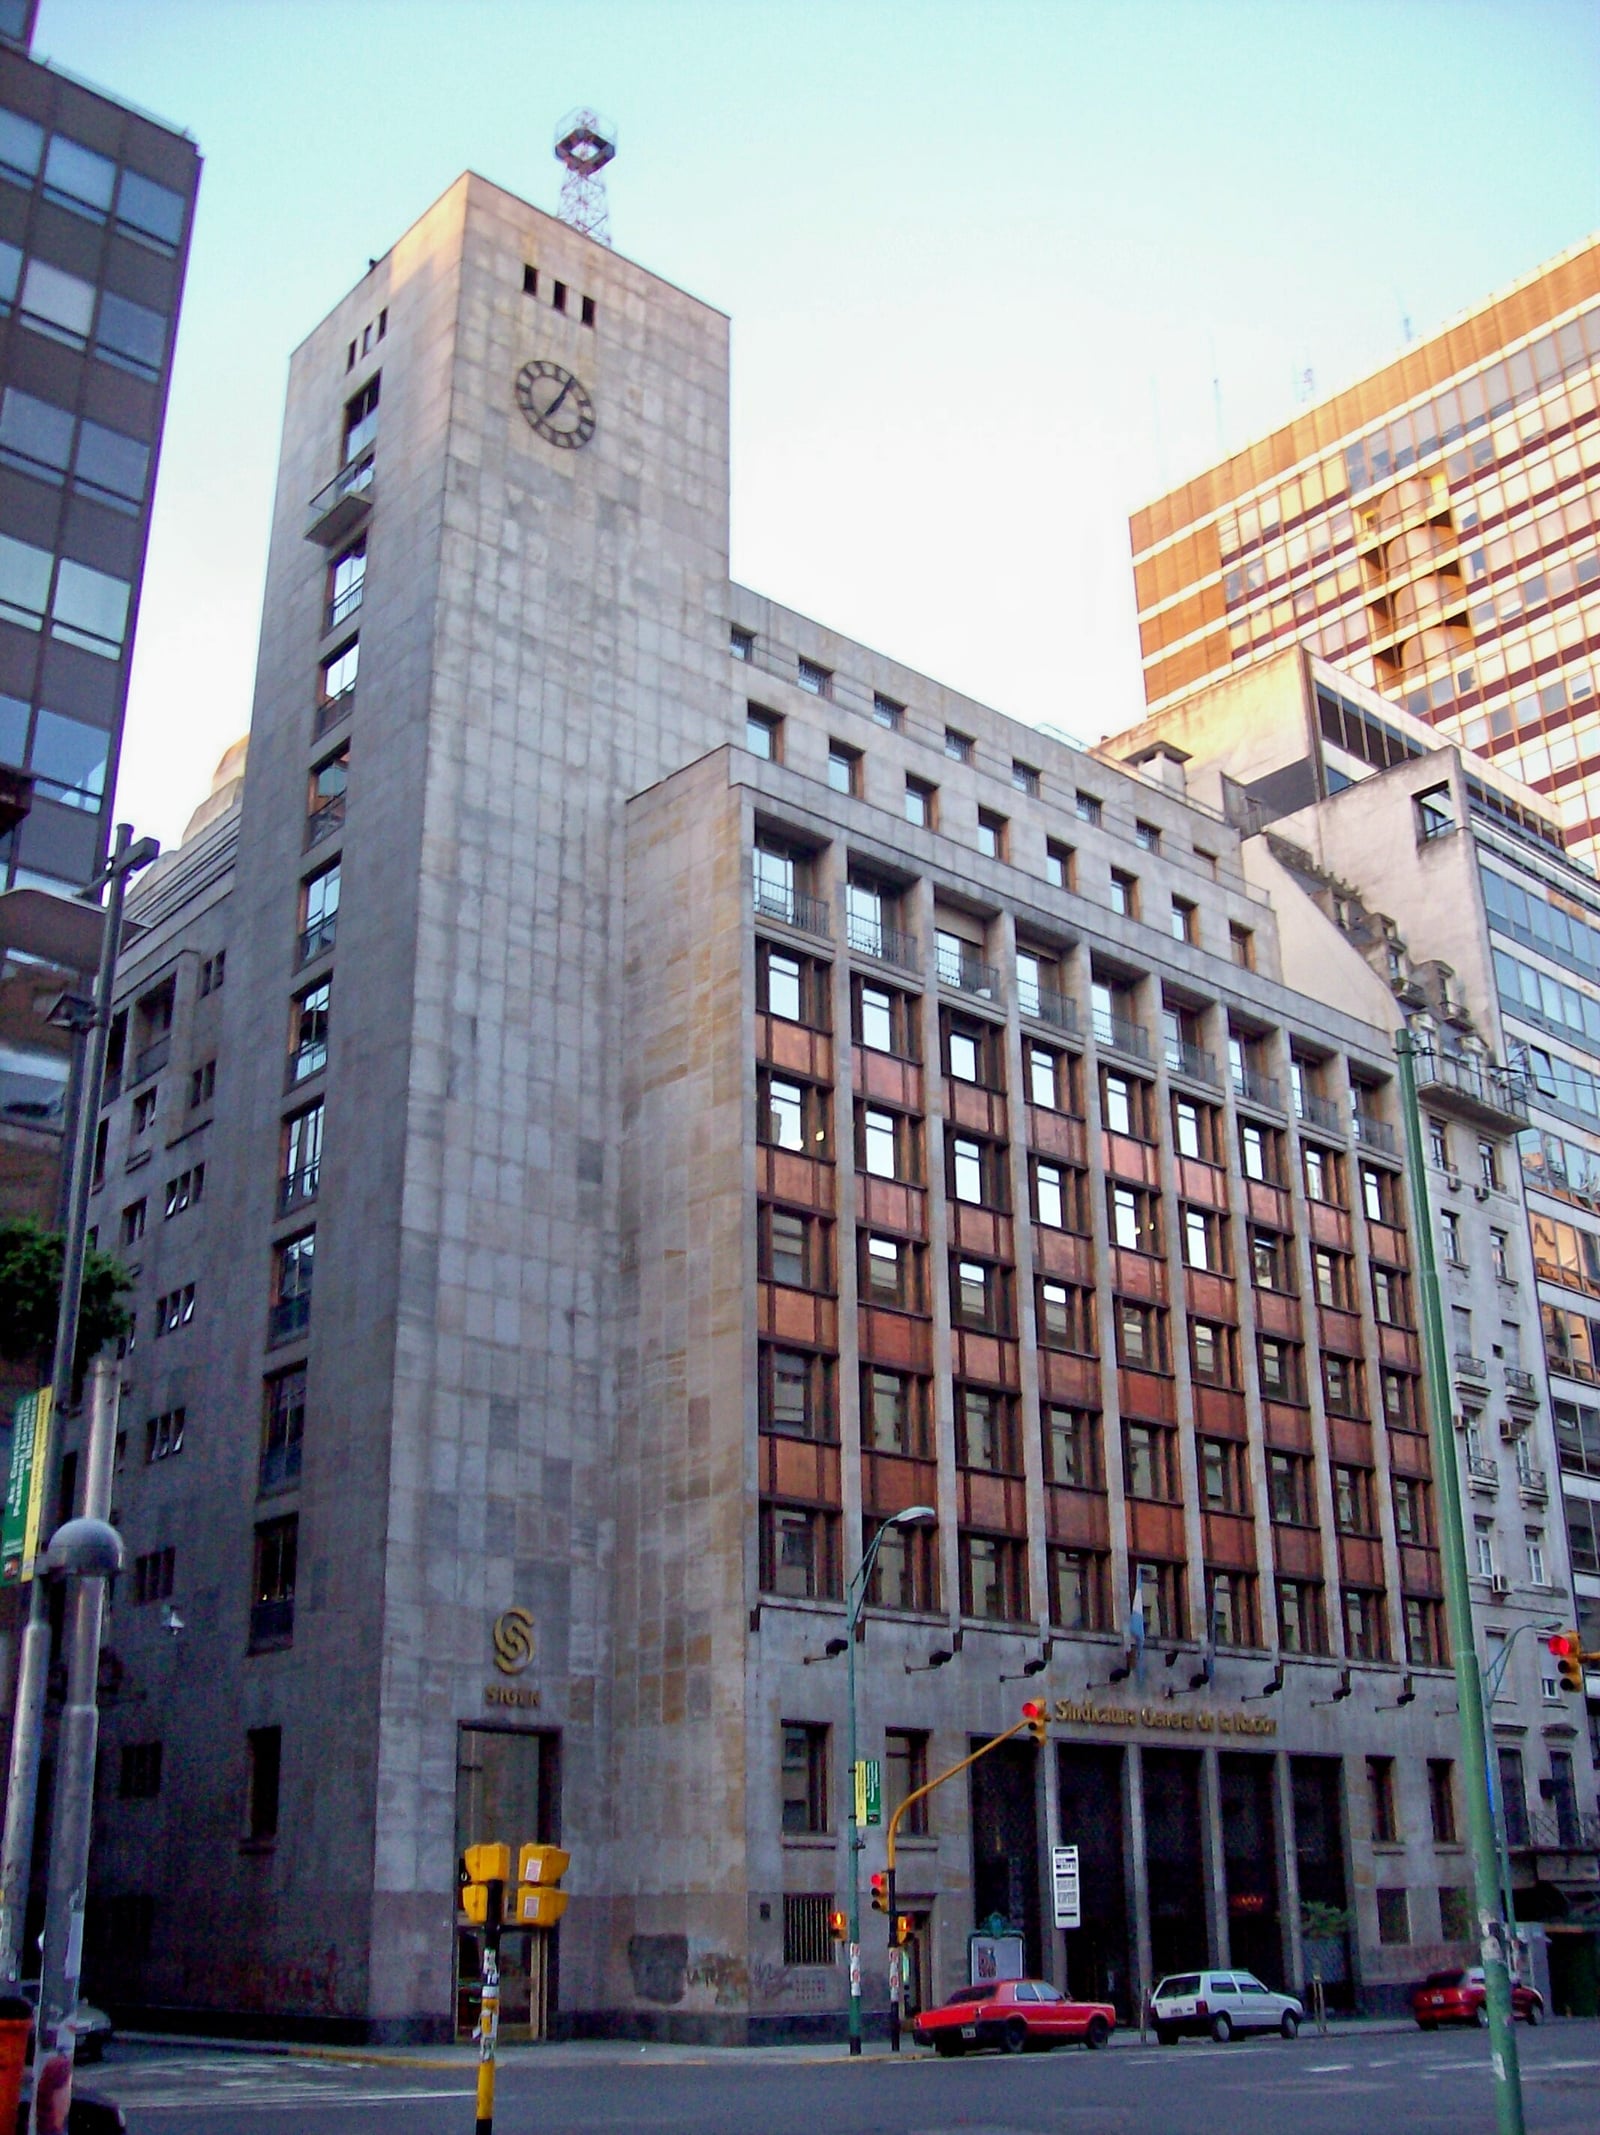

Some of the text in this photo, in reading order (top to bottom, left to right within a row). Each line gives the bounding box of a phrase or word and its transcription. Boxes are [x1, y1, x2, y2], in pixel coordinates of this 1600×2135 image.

[1055, 1699, 1137, 1726] Sindicatura
[1141, 1704, 1193, 1730] General
[1197, 1709, 1214, 1732] de
